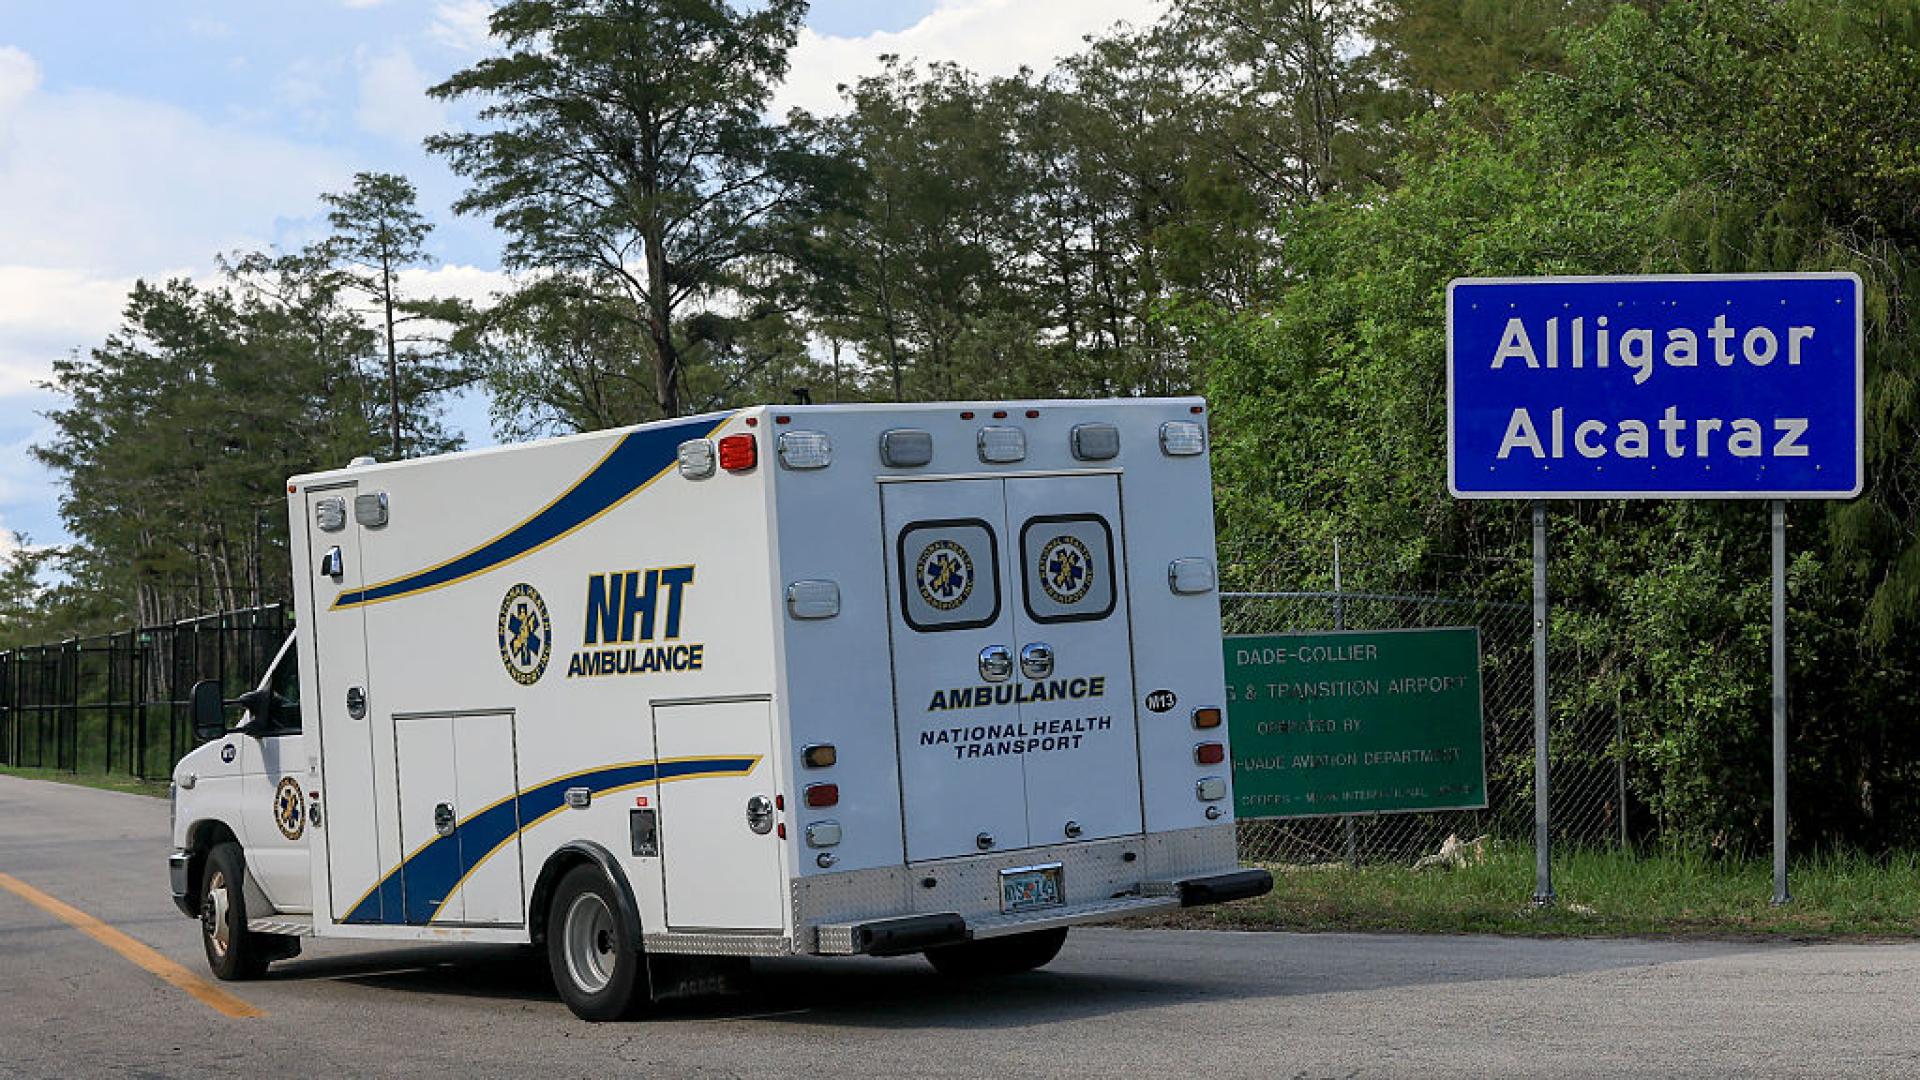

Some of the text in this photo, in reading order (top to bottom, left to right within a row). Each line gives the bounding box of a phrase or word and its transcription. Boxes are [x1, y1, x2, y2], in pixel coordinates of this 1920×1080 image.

[1490, 314, 1815, 385] Alligator
[1496, 405, 1810, 459] Alcatraz
[583, 564, 696, 647] NHT
[567, 643, 704, 679] AMBULANCE
[1237, 645, 1377, 665] DADE-COLLIER
[928, 677, 1105, 711] AMBULANCE
[1148, 694, 1174, 709] M13
[1245, 684, 1257, 701] &
[1265, 680, 1379, 700] TRANSITION
[1389, 676, 1467, 694] AIRPORT
[920, 715, 1112, 745] NATIONAL HEALTH
[954, 735, 1084, 760] TRANSPORT
